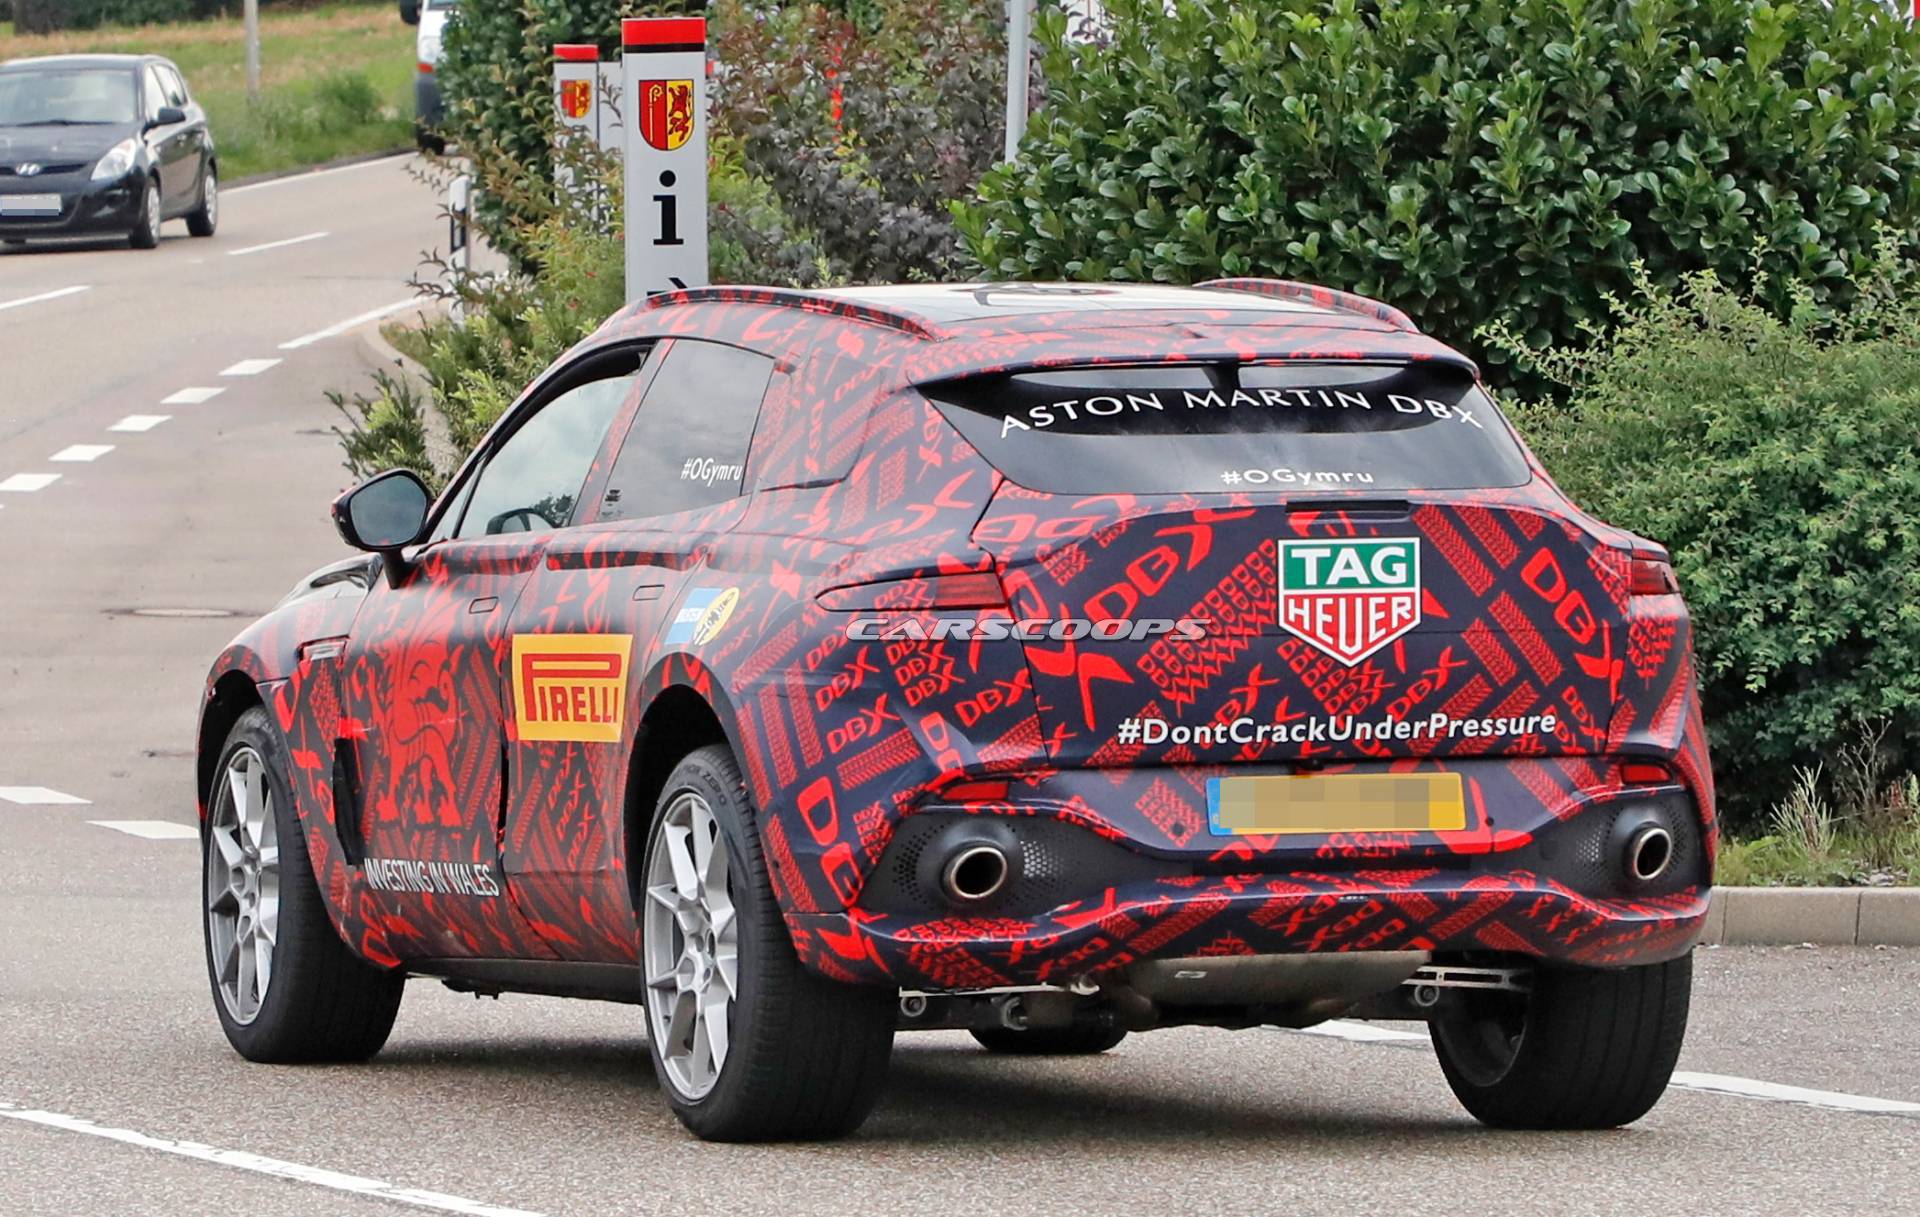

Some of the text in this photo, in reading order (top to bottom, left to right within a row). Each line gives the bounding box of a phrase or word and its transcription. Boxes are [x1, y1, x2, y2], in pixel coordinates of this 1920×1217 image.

[653, 170, 684, 246] i
[1001, 388, 1484, 438] ASTON MARTIN DBX
[680, 457, 743, 488] #OGymru
[1220, 468, 1375, 486] #OGymru
[1084, 503, 1256, 632] DBX
[1291, 546, 1408, 586] TAG
[1287, 596, 1413, 656] HEUER
[1521, 547, 1625, 706] DBX
[521, 653, 622, 723] PIRELLI
[814, 645, 880, 713] DBX
[904, 661, 966, 708] DBX
[955, 667, 1032, 728] DBX
[1386, 646, 1469, 723] DBX
[826, 692, 901, 755] DBX
[1117, 713, 1557, 745] #DontCrackUnderPressure
[1561, 686, 1607, 752] DBX
[364, 857, 500, 897] INVESTING IN WALES
